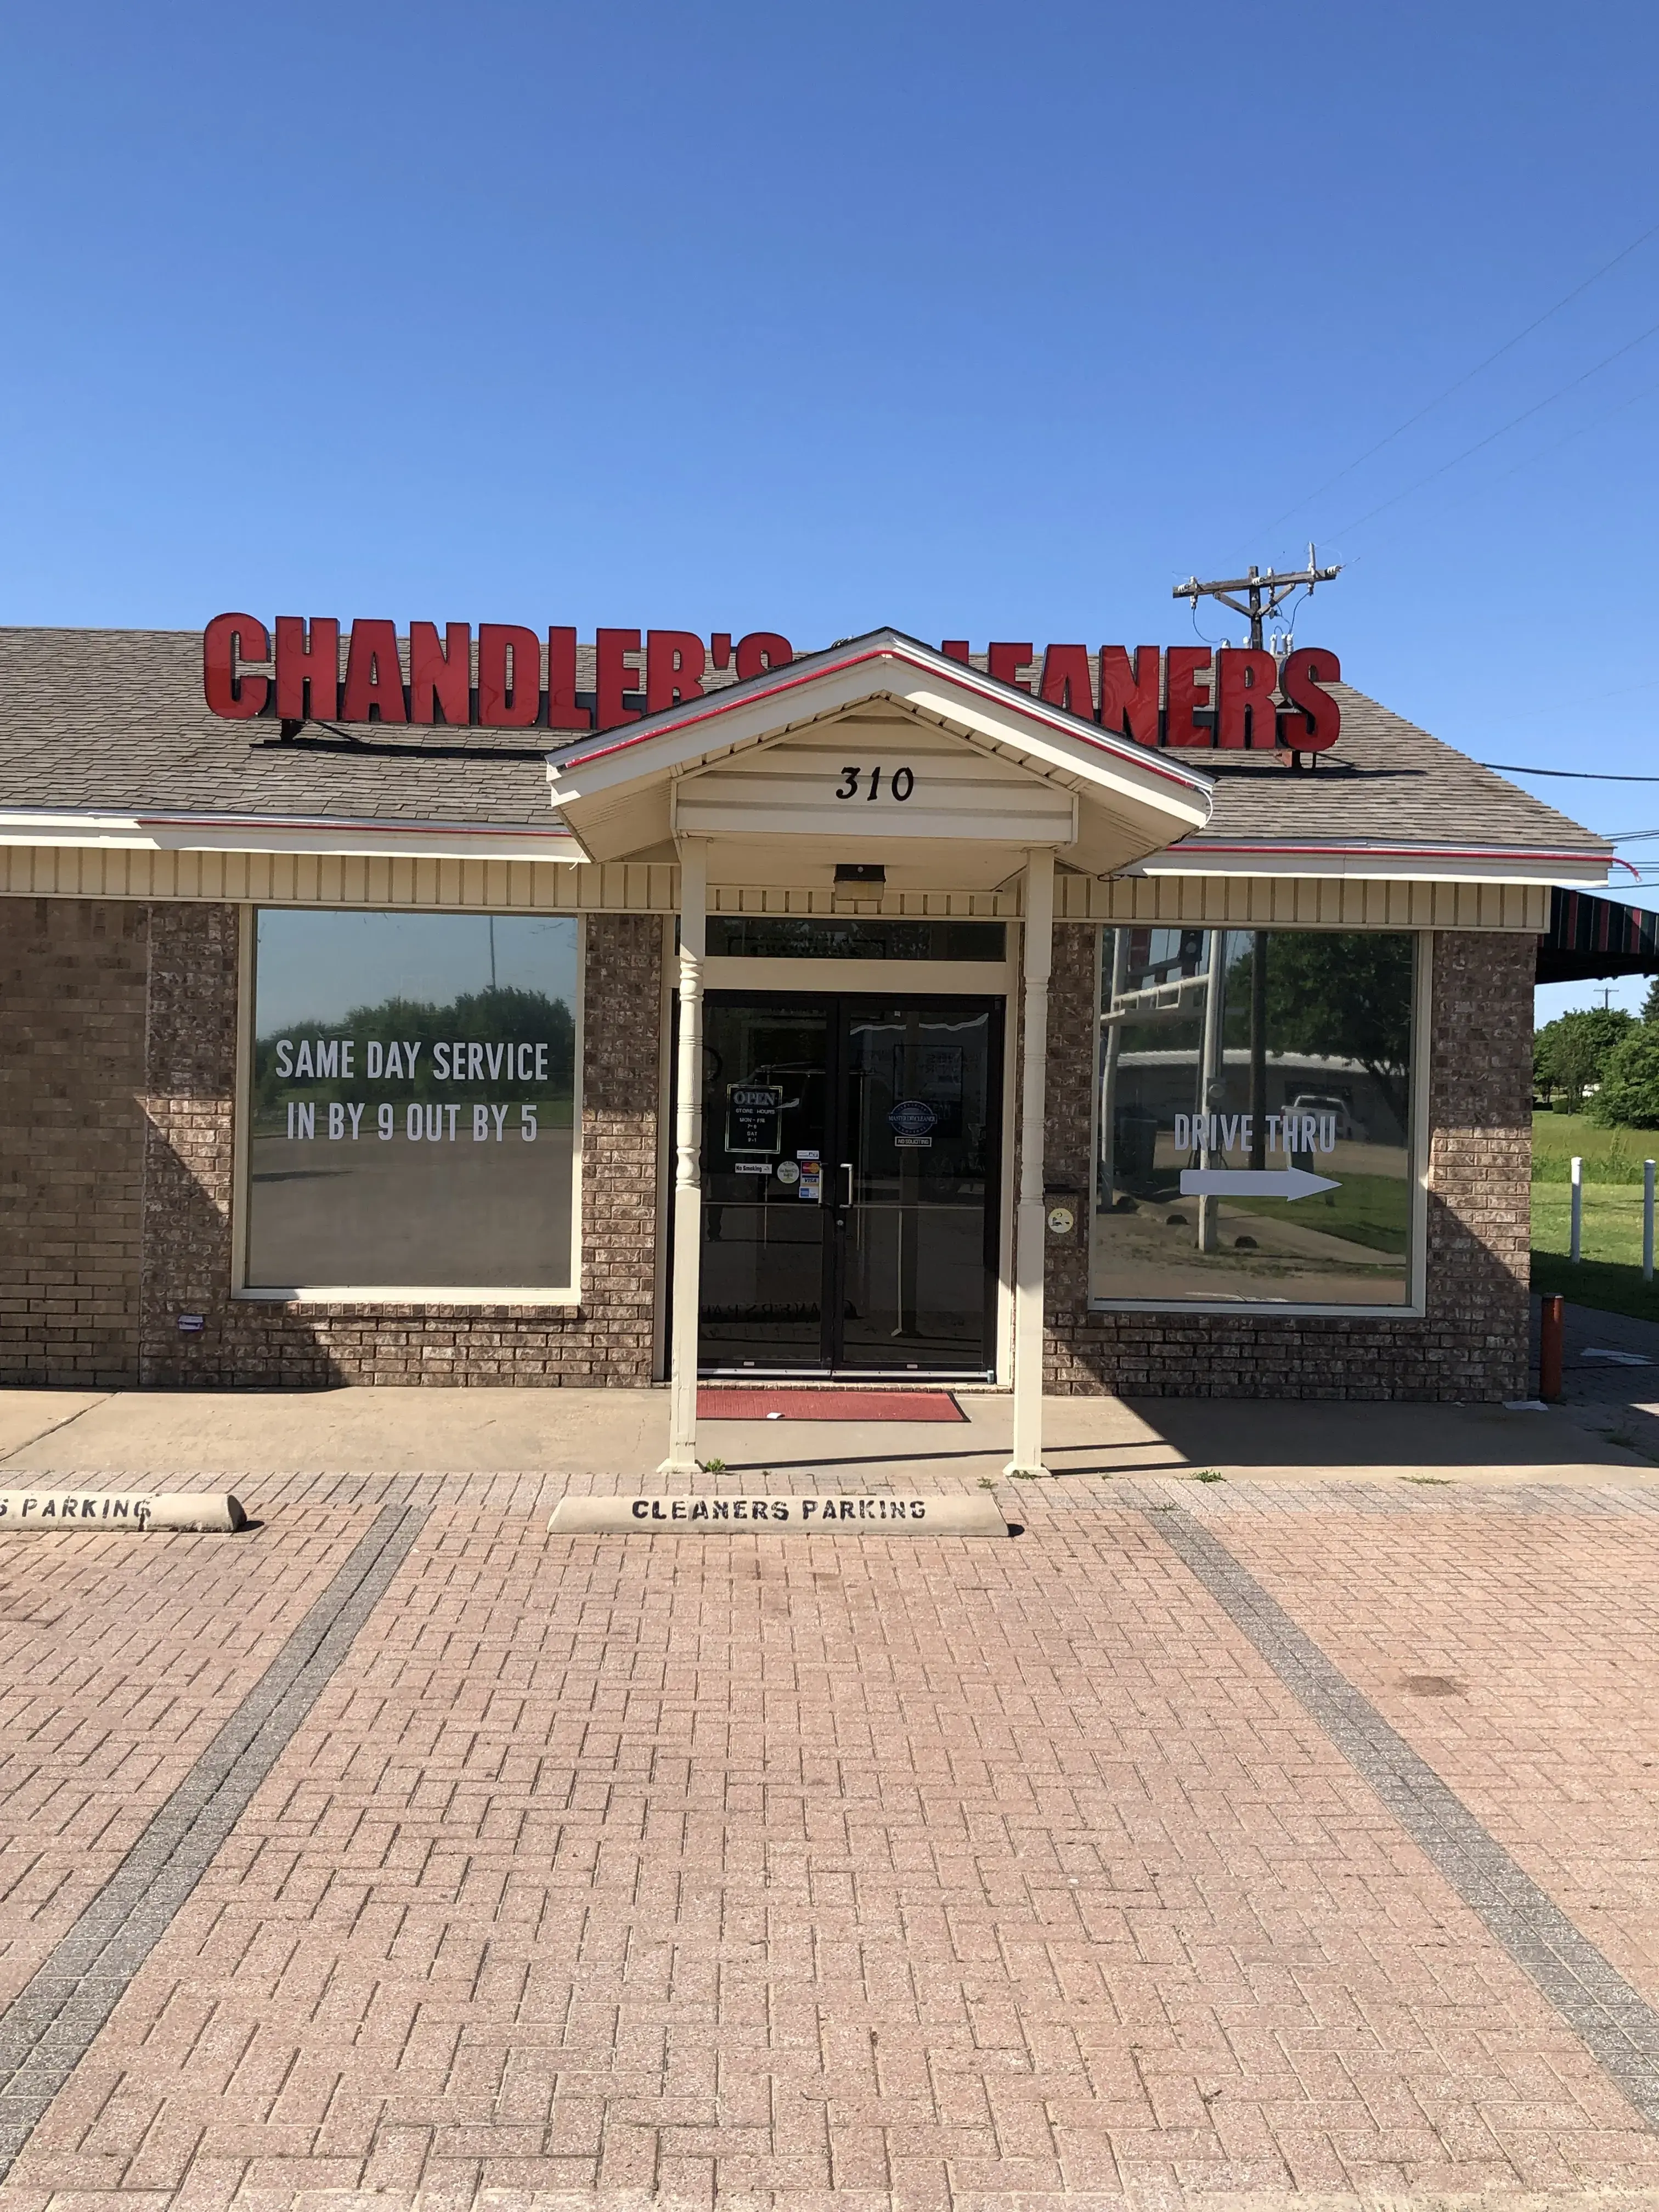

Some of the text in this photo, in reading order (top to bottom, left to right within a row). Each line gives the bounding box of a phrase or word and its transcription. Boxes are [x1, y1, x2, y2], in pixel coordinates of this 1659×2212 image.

[835, 766, 914, 802] 310
[275, 1040, 548, 1080] SAME DAY SERVICE
[733, 1091, 776, 1106] OPEN
[287, 1102, 537, 1142] IN BY 9 OUT BY 5
[1175, 1114, 1336, 1153] DRIVE THRU
[21, 1497, 151, 1519] PARKING
[631, 1500, 926, 1521] CLEANERS PARKING
